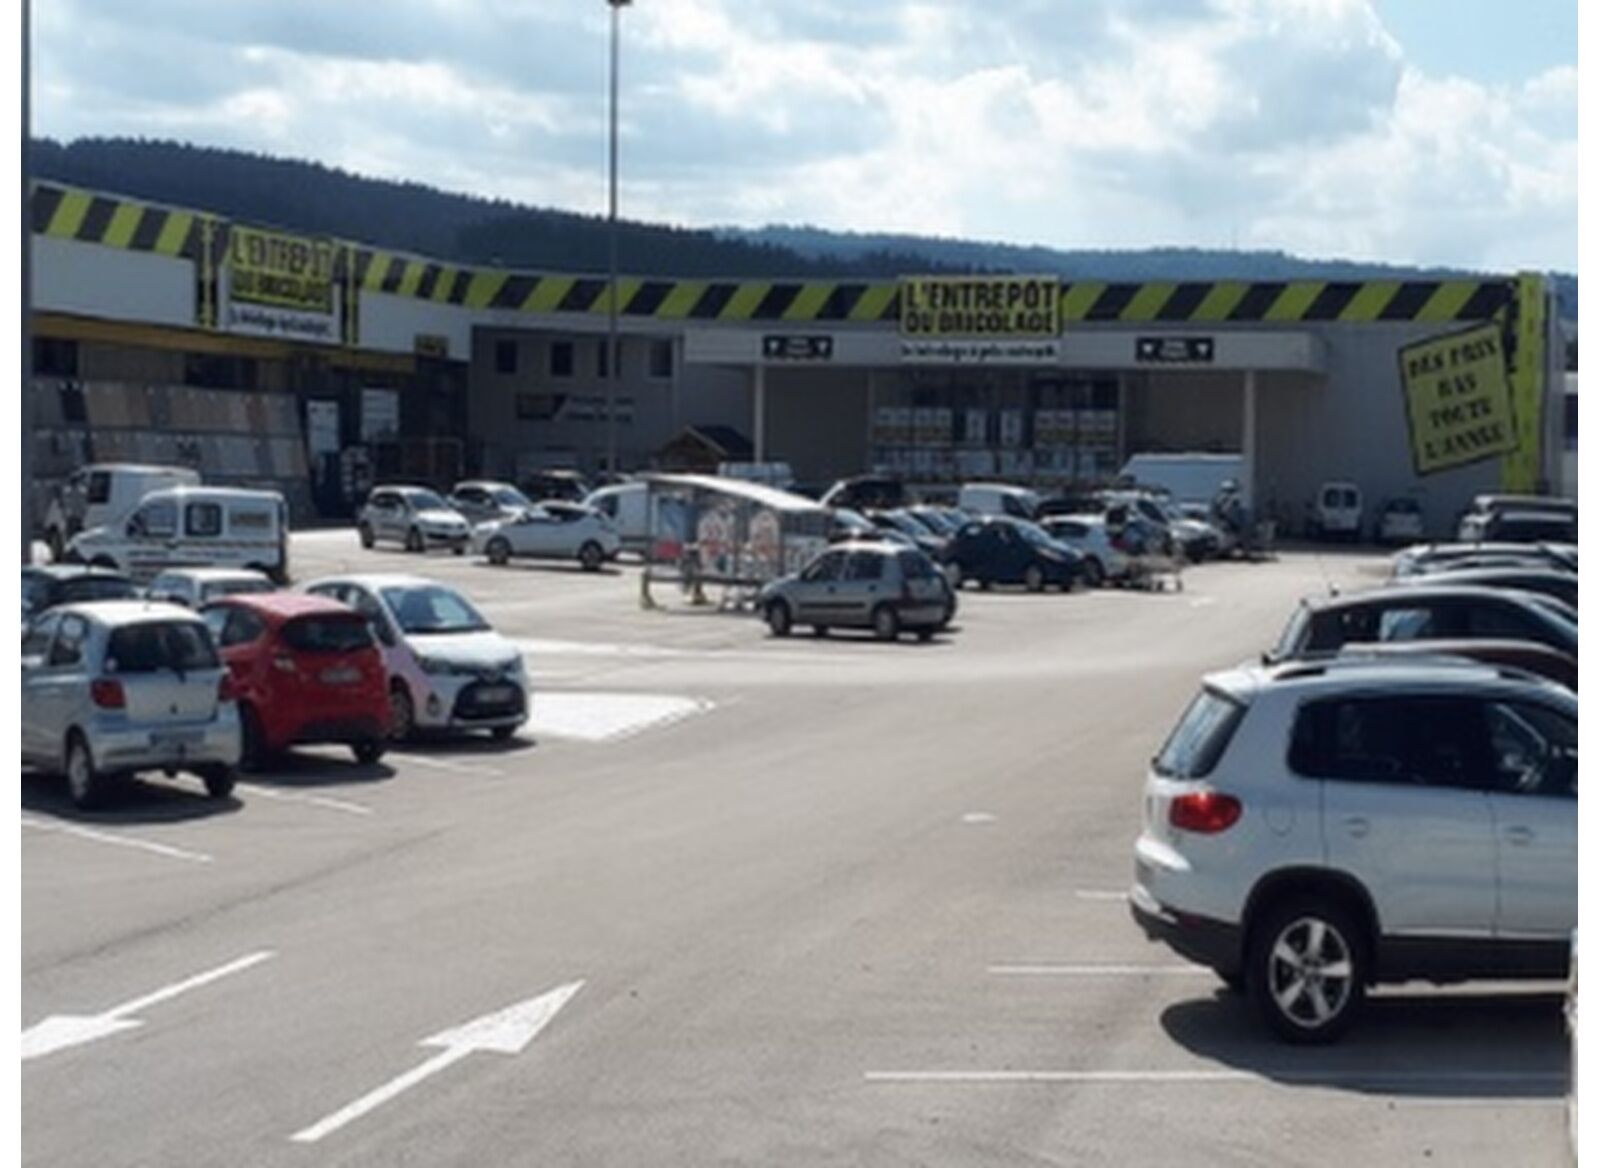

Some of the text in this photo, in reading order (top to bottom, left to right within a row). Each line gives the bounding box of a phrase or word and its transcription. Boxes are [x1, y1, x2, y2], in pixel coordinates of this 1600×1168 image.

[905, 311, 1054, 333] DU BRICOLAGE
[1408, 352, 1443, 379] DES
[1438, 373, 1477, 397] BAS
